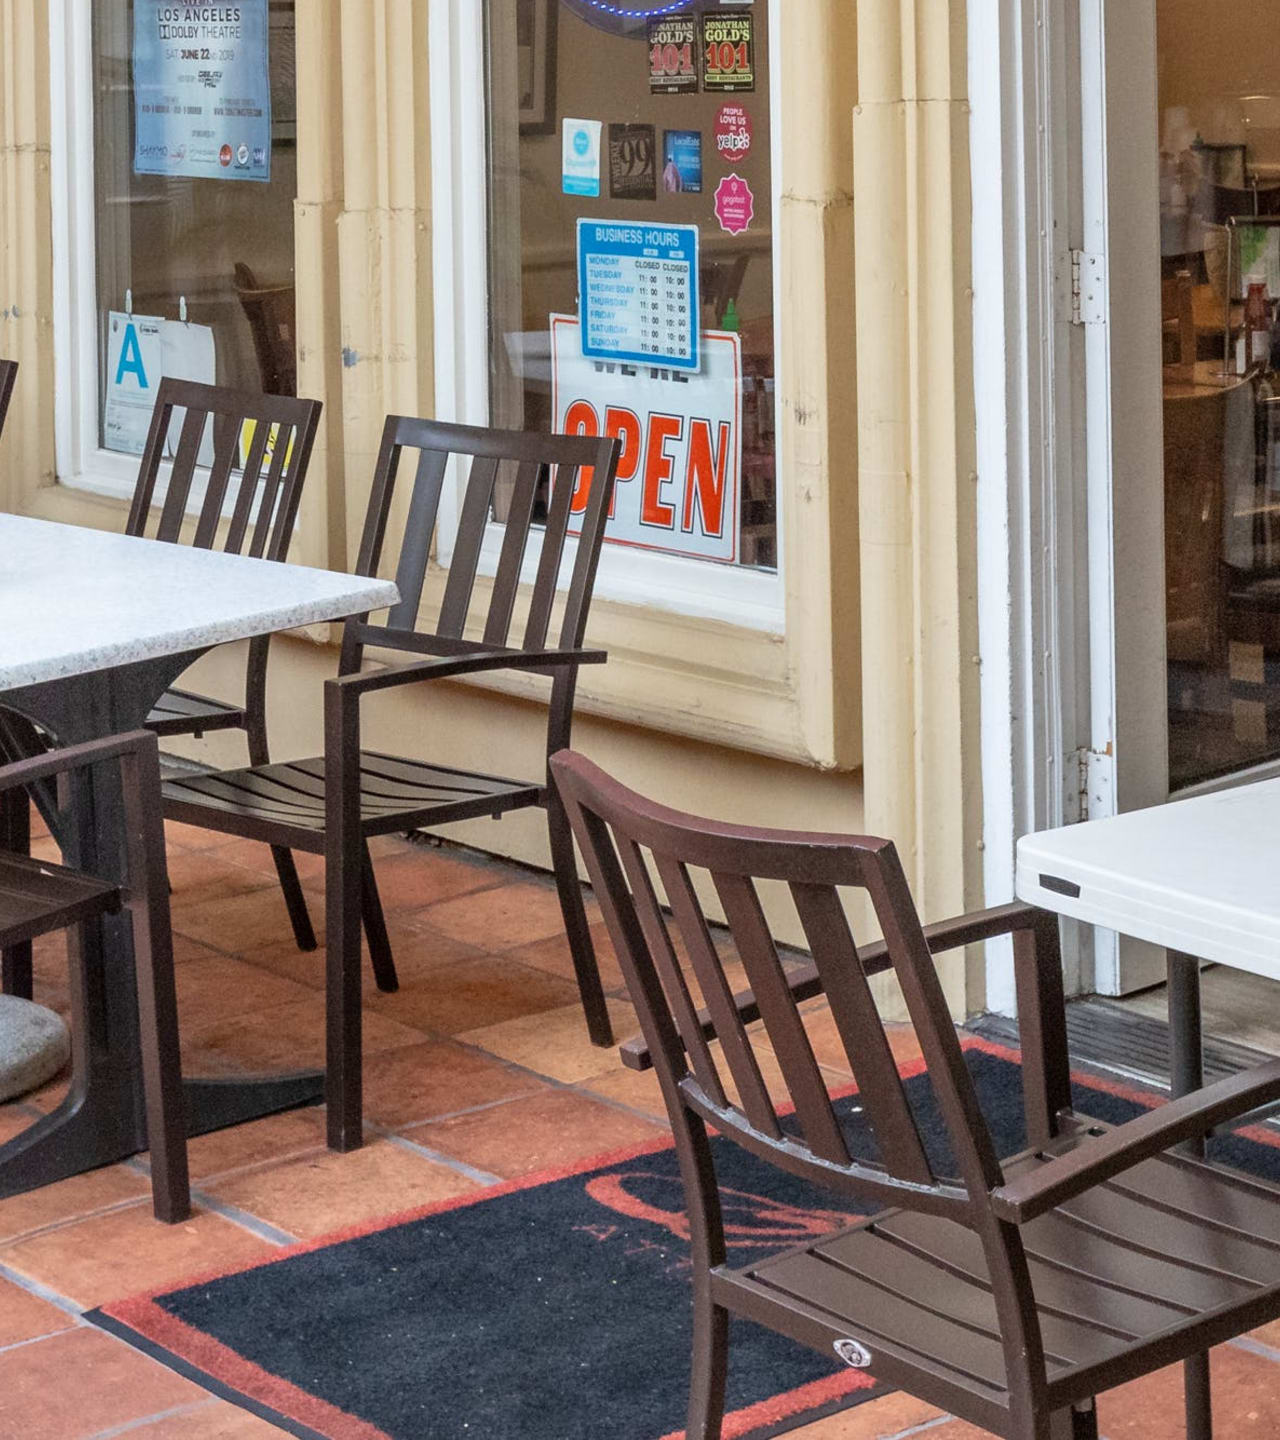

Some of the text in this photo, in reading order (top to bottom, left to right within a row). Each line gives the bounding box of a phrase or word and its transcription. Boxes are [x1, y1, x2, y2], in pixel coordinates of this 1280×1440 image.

[157, 7, 241, 22] LOS ANGELES
[171, 25, 241, 39] DOLBY THEATRE
[705, 20, 750, 30] JONATHAN
[705, 29, 751, 42] GOLD'S
[180, 48, 199, 61] JUNE
[650, 42, 695, 76] 101
[705, 41, 751, 74] 101
[719, 115, 746, 125] LOVE US
[717, 133, 741, 151] yelp
[620, 137, 651, 177] 99
[595, 227, 680, 247] BUSINESS HOURS
[635, 260, 661, 270] CLOSED
[663, 262, 689, 273] CLOSED
[115, 323, 150, 389] A
[562, 398, 731, 539] OPEN
